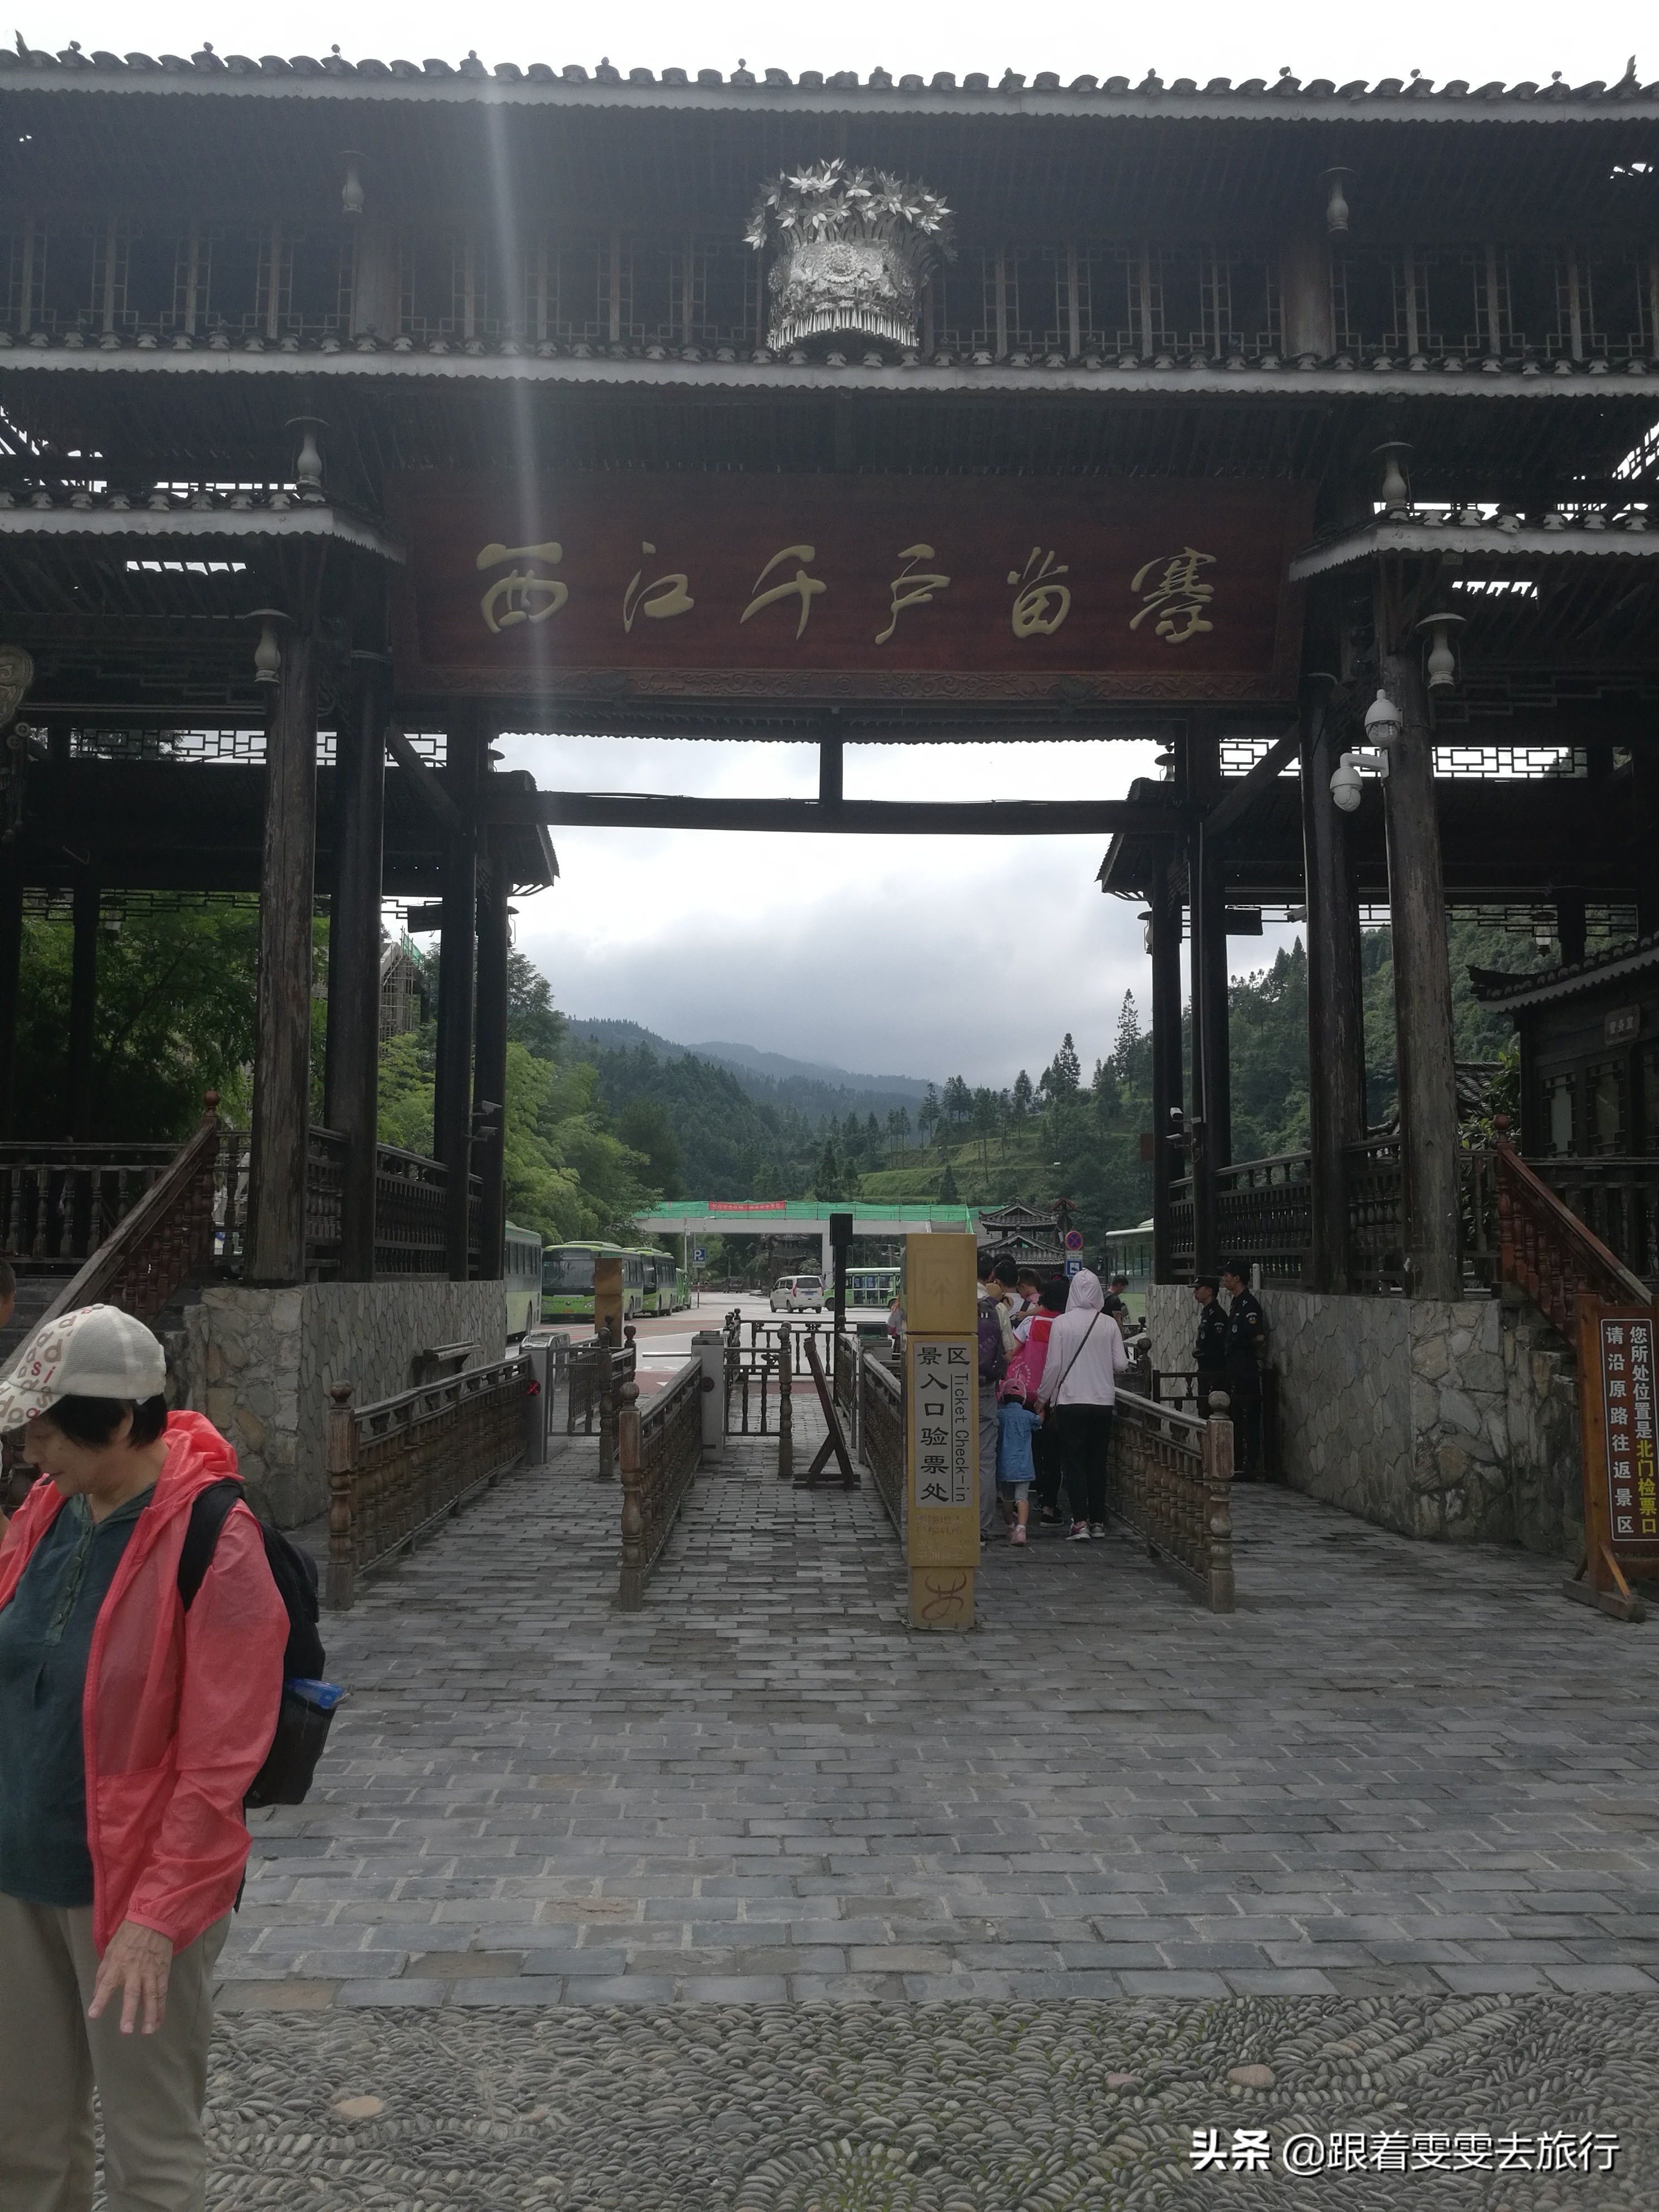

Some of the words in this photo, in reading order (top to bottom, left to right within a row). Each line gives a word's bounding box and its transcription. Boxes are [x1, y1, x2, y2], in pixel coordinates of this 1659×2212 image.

[476, 541, 1217, 645] 西江千户苗寨
[694, 1249, 702, 1260] P
[954, 1373, 969, 1424] Ticket
[1605, 1326, 1634, 1534] 请沿原路往返景区
[1629, 1326, 1657, 1534] 您所处位置是北门检票口
[954, 1430, 969, 1502] Check-in
